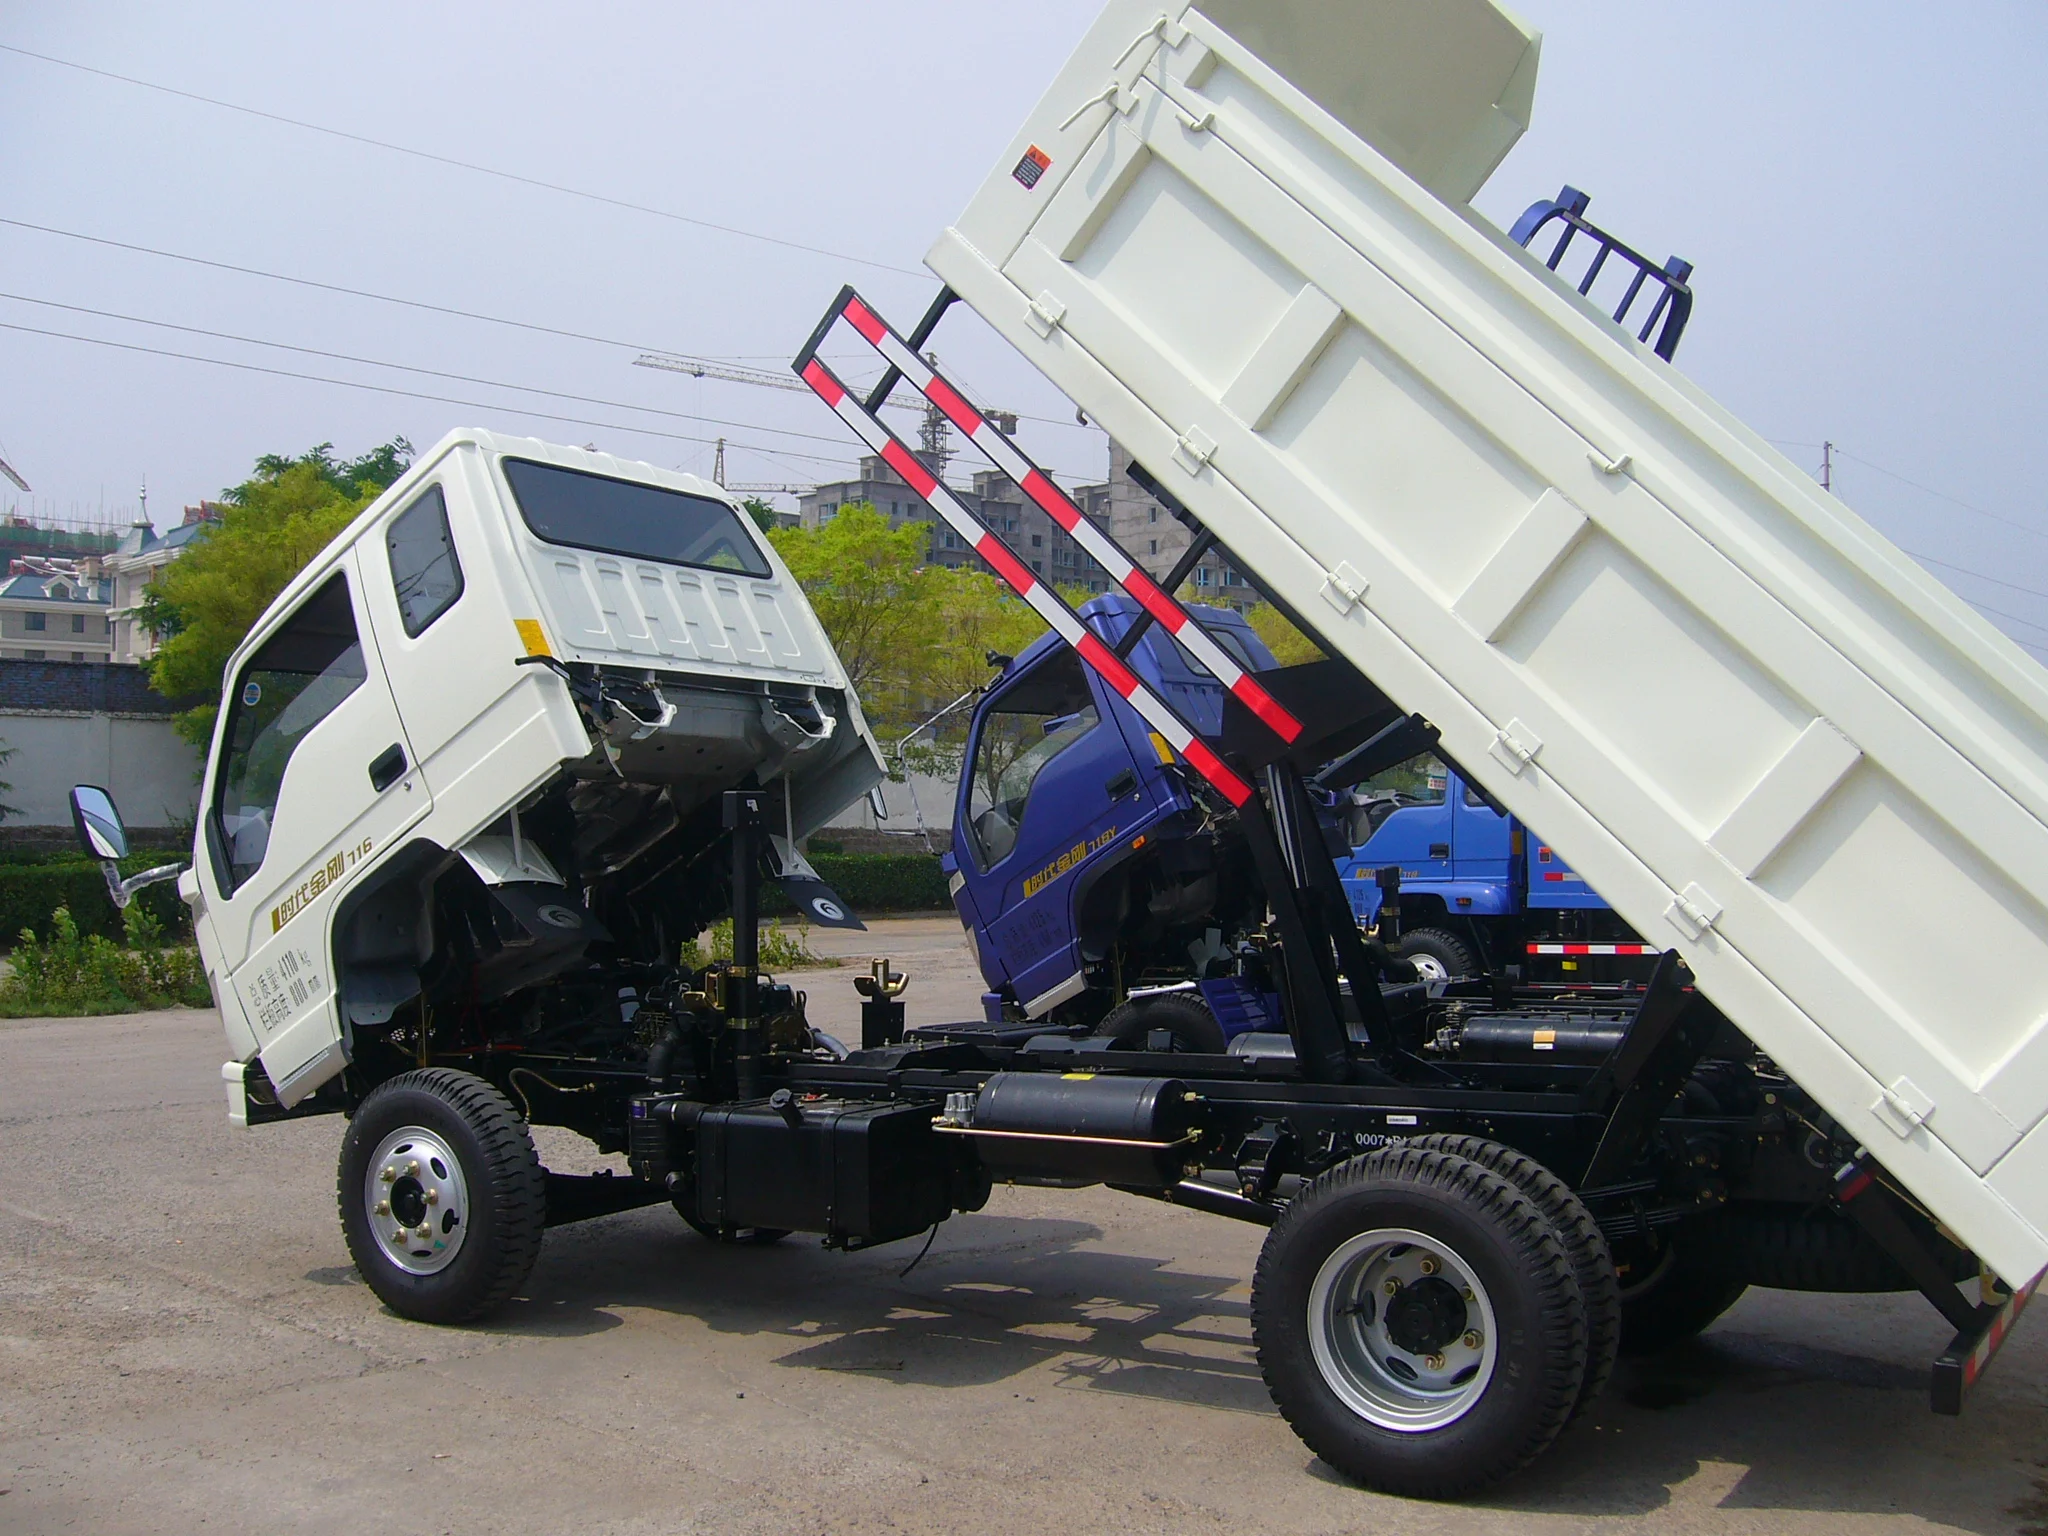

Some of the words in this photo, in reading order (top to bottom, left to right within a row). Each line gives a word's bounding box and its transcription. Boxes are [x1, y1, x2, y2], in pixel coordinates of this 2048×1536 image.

[280, 850, 345, 922] 时代金刚
[347, 836, 373, 865] 716
[1031, 840, 1088, 890] 时代金刚
